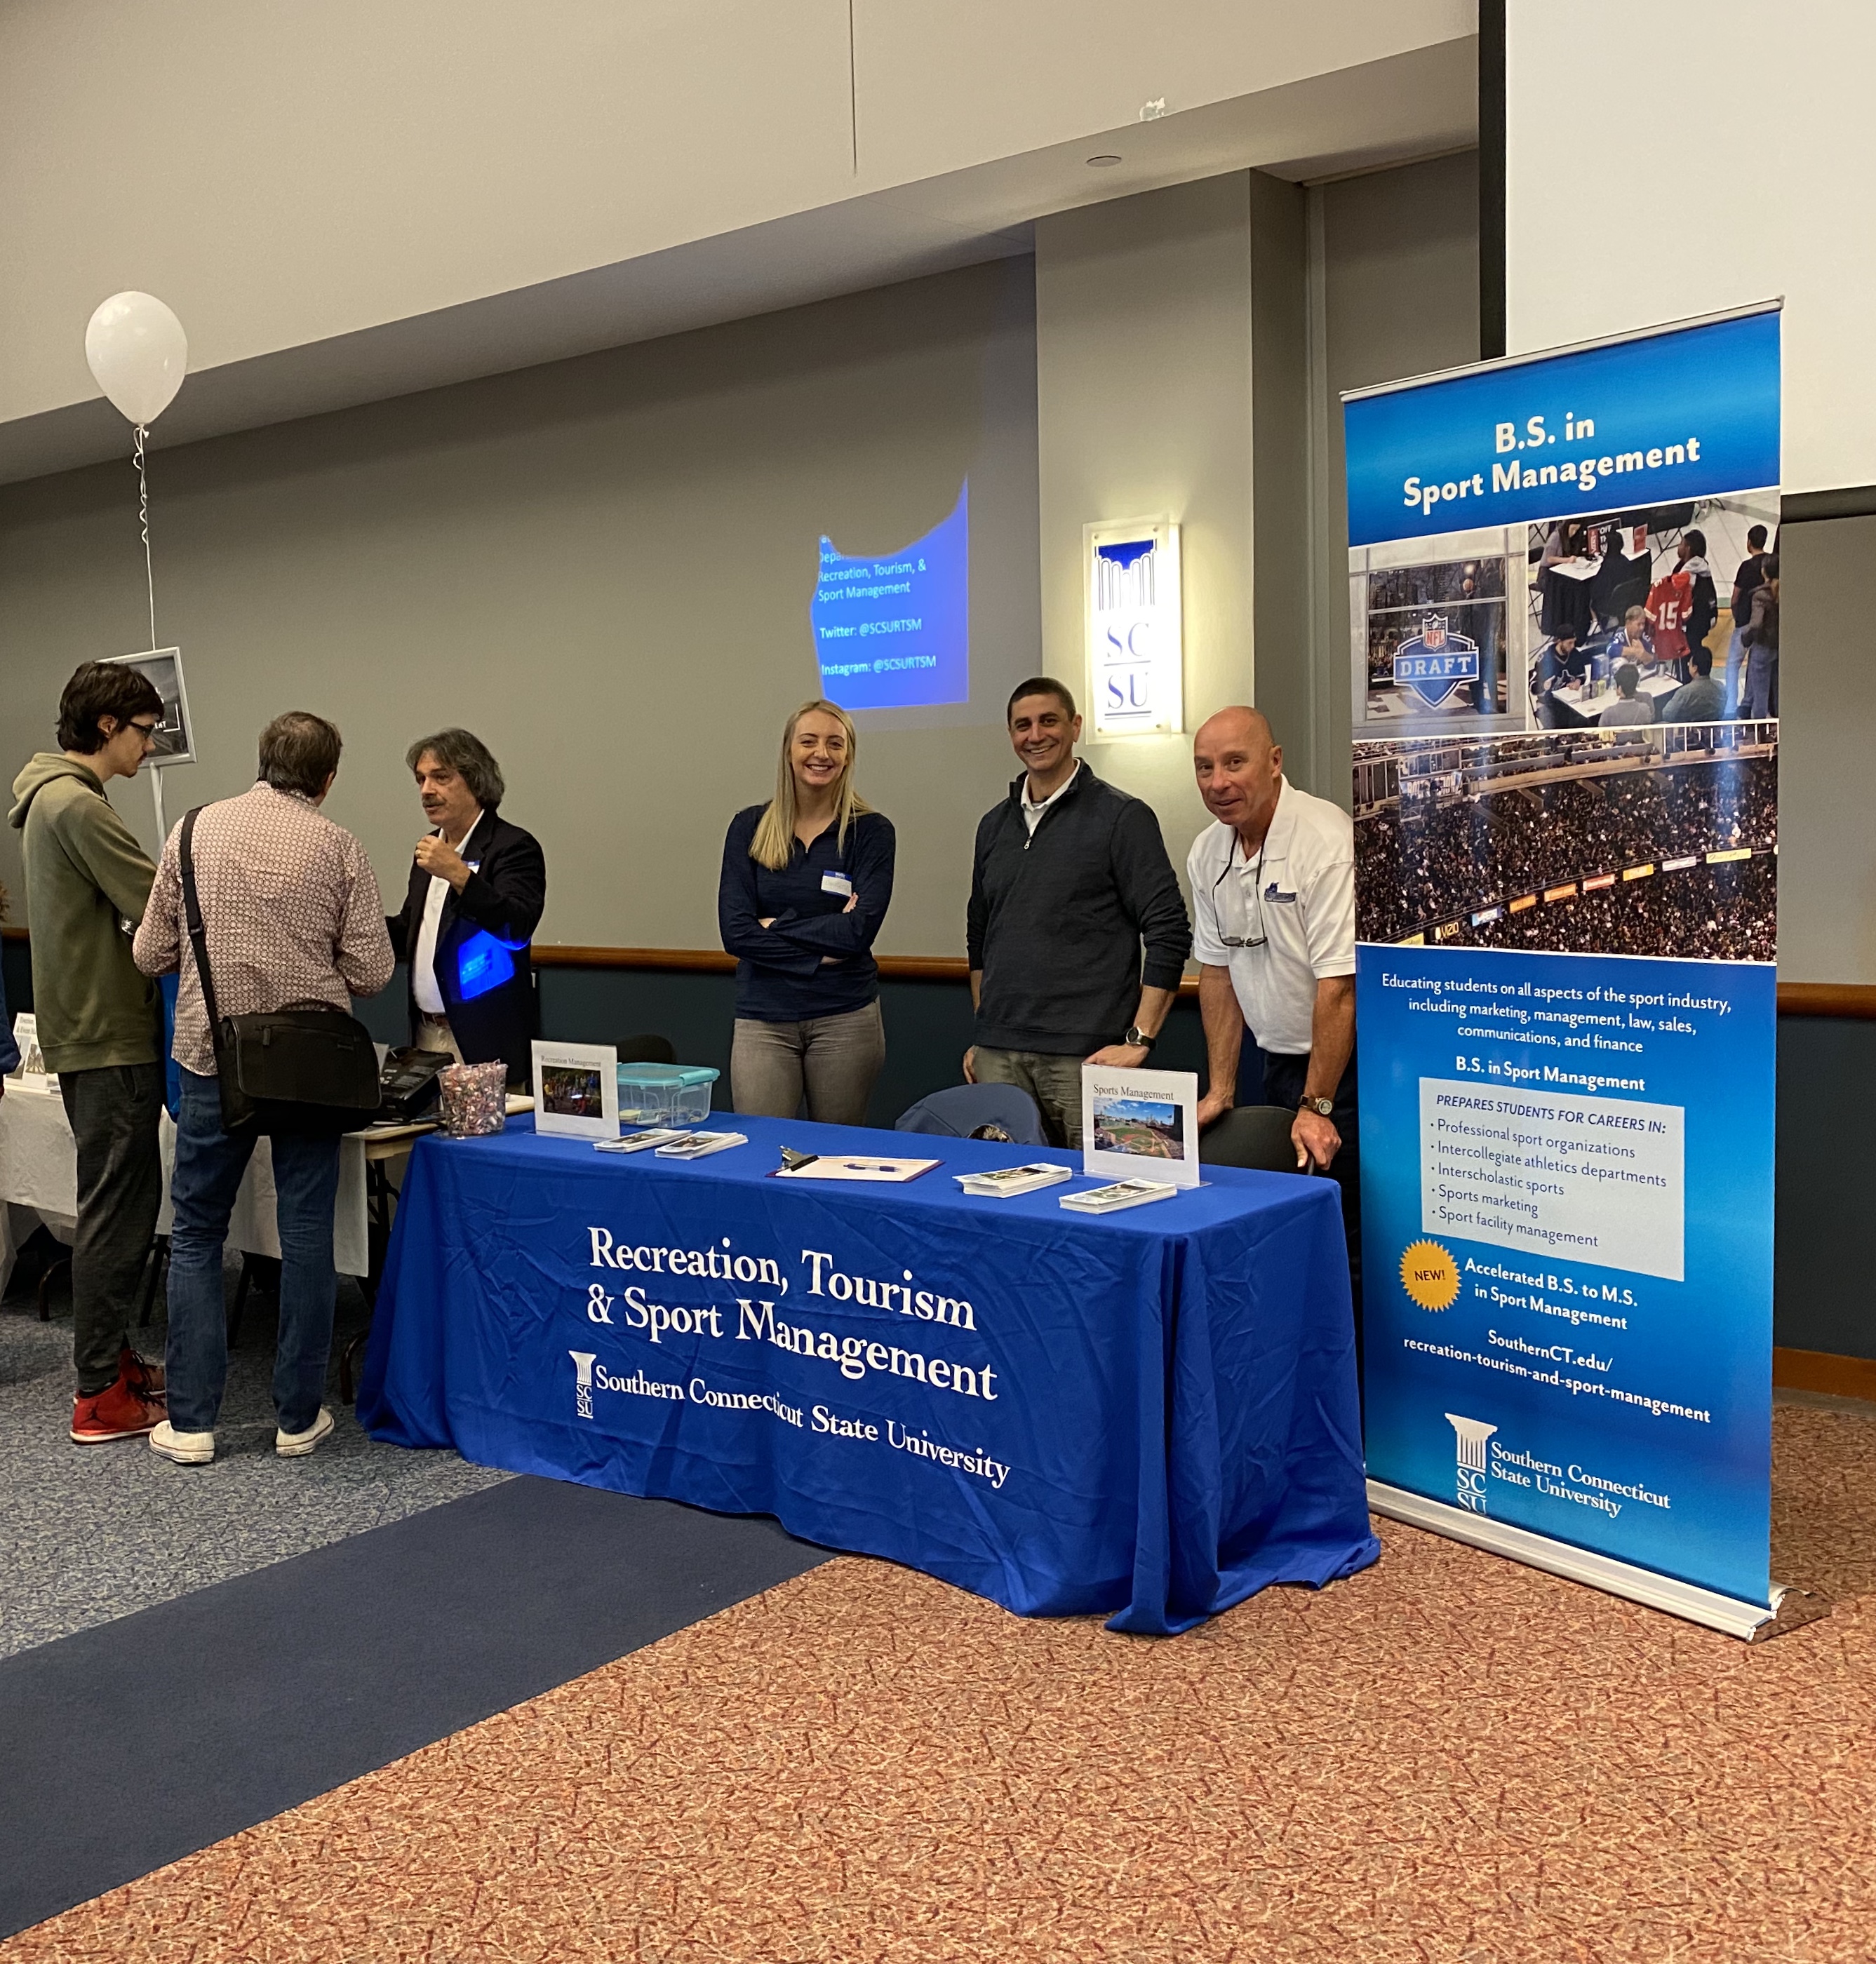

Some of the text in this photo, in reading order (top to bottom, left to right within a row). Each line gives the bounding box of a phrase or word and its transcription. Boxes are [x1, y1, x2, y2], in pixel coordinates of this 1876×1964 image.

[1496, 412, 1594, 453] B.S. in
[1404, 438, 1700, 516] Sport Management
[818, 558, 926, 582] Recreation, Tourism, &
[818, 581, 911, 603] Sport Management
[820, 619, 923, 639] Twitter: @SCSURTSM
[1658, 601, 1680, 630] 15
[1106, 622, 1150, 658] SC
[1426, 631, 1445, 646] NFL
[821, 655, 937, 677] Instagram: @SCSURTSM
[1400, 657, 1472, 677] DRAFT
[1107, 671, 1149, 710] SU
[1382, 973, 1731, 1016] Educating students on all aspects of the sport industry,
[1409, 997, 1696, 1035] including marketing, management, law, sales,
[1457, 1027, 1643, 1052] communications, and finance
[1456, 1056, 1645, 1091] B.S. in Sport Management
[1094, 1084, 1174, 1101] Sports Management
[1437, 1095, 1666, 1134] PREPARES STUDENTS FOR CAREERS IN:
[1438, 1118, 1635, 1158] Professional sport organizations
[1438, 1141, 1666, 1187] Intercollegiate athletics departments
[1439, 1162, 1564, 1195] Interscholastic sports
[1439, 1184, 1538, 1219] Sports marketing
[1439, 1206, 1598, 1247] Sport facility management
[587, 1226, 977, 1331] Recreation, Tourism
[1413, 1269, 1446, 1283] NEW!
[1465, 1258, 1637, 1307] Accelerated B.S. to M.S.
[1475, 1284, 1628, 1330] in Sport Management
[587, 1283, 998, 1401] & Sport Management
[1488, 1329, 1613, 1372] SouthernCT.edu/
[577, 1384, 592, 1399] SC
[1404, 1337, 1710, 1423] recreation-tourism-and-sport-management
[577, 1401, 593, 1415] SU
[596, 1365, 1011, 1488] Southern Connecticut State University
[1456, 1467, 1487, 1494] SC
[1492, 1441, 1671, 1509] Southern Connecticut
[1492, 1461, 1622, 1518] State University
[1457, 1492, 1487, 1515] SU
